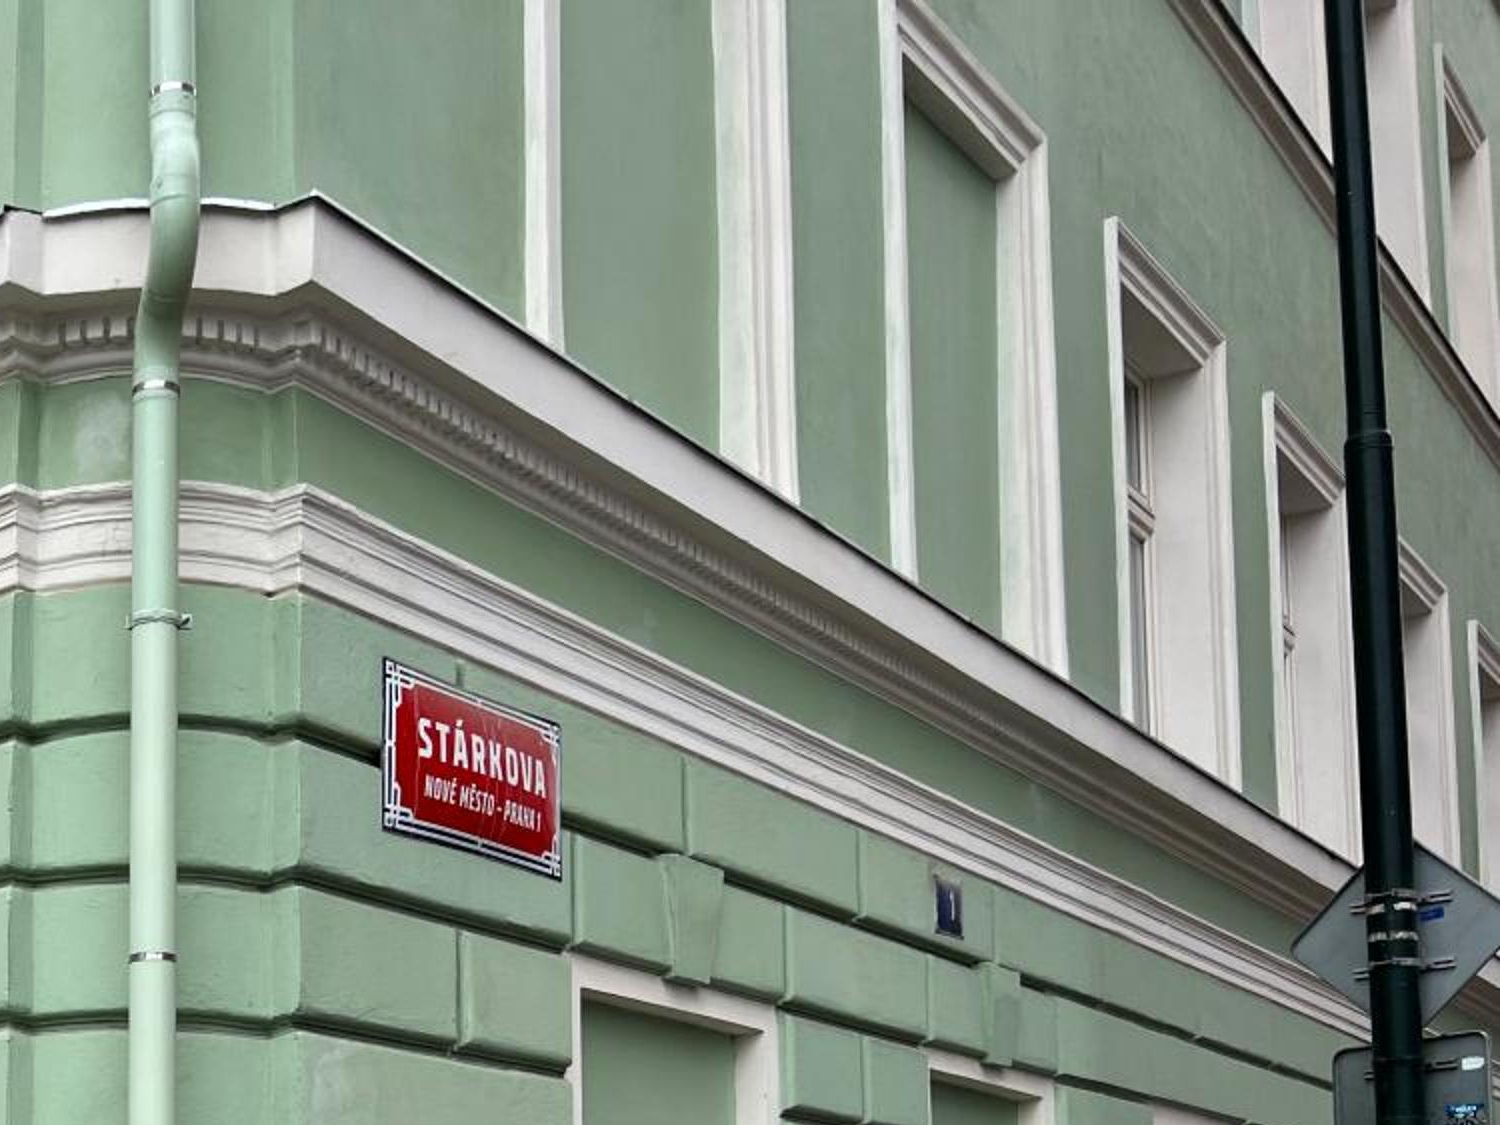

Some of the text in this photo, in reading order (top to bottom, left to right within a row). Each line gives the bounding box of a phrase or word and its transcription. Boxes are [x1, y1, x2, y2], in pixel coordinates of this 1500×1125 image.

[418, 717, 547, 798] STÁRKOVA
[423, 773, 458, 805] NOVÉ
[459, 783, 495, 817] MĚSTO
[503, 799, 535, 831] PRAHA
